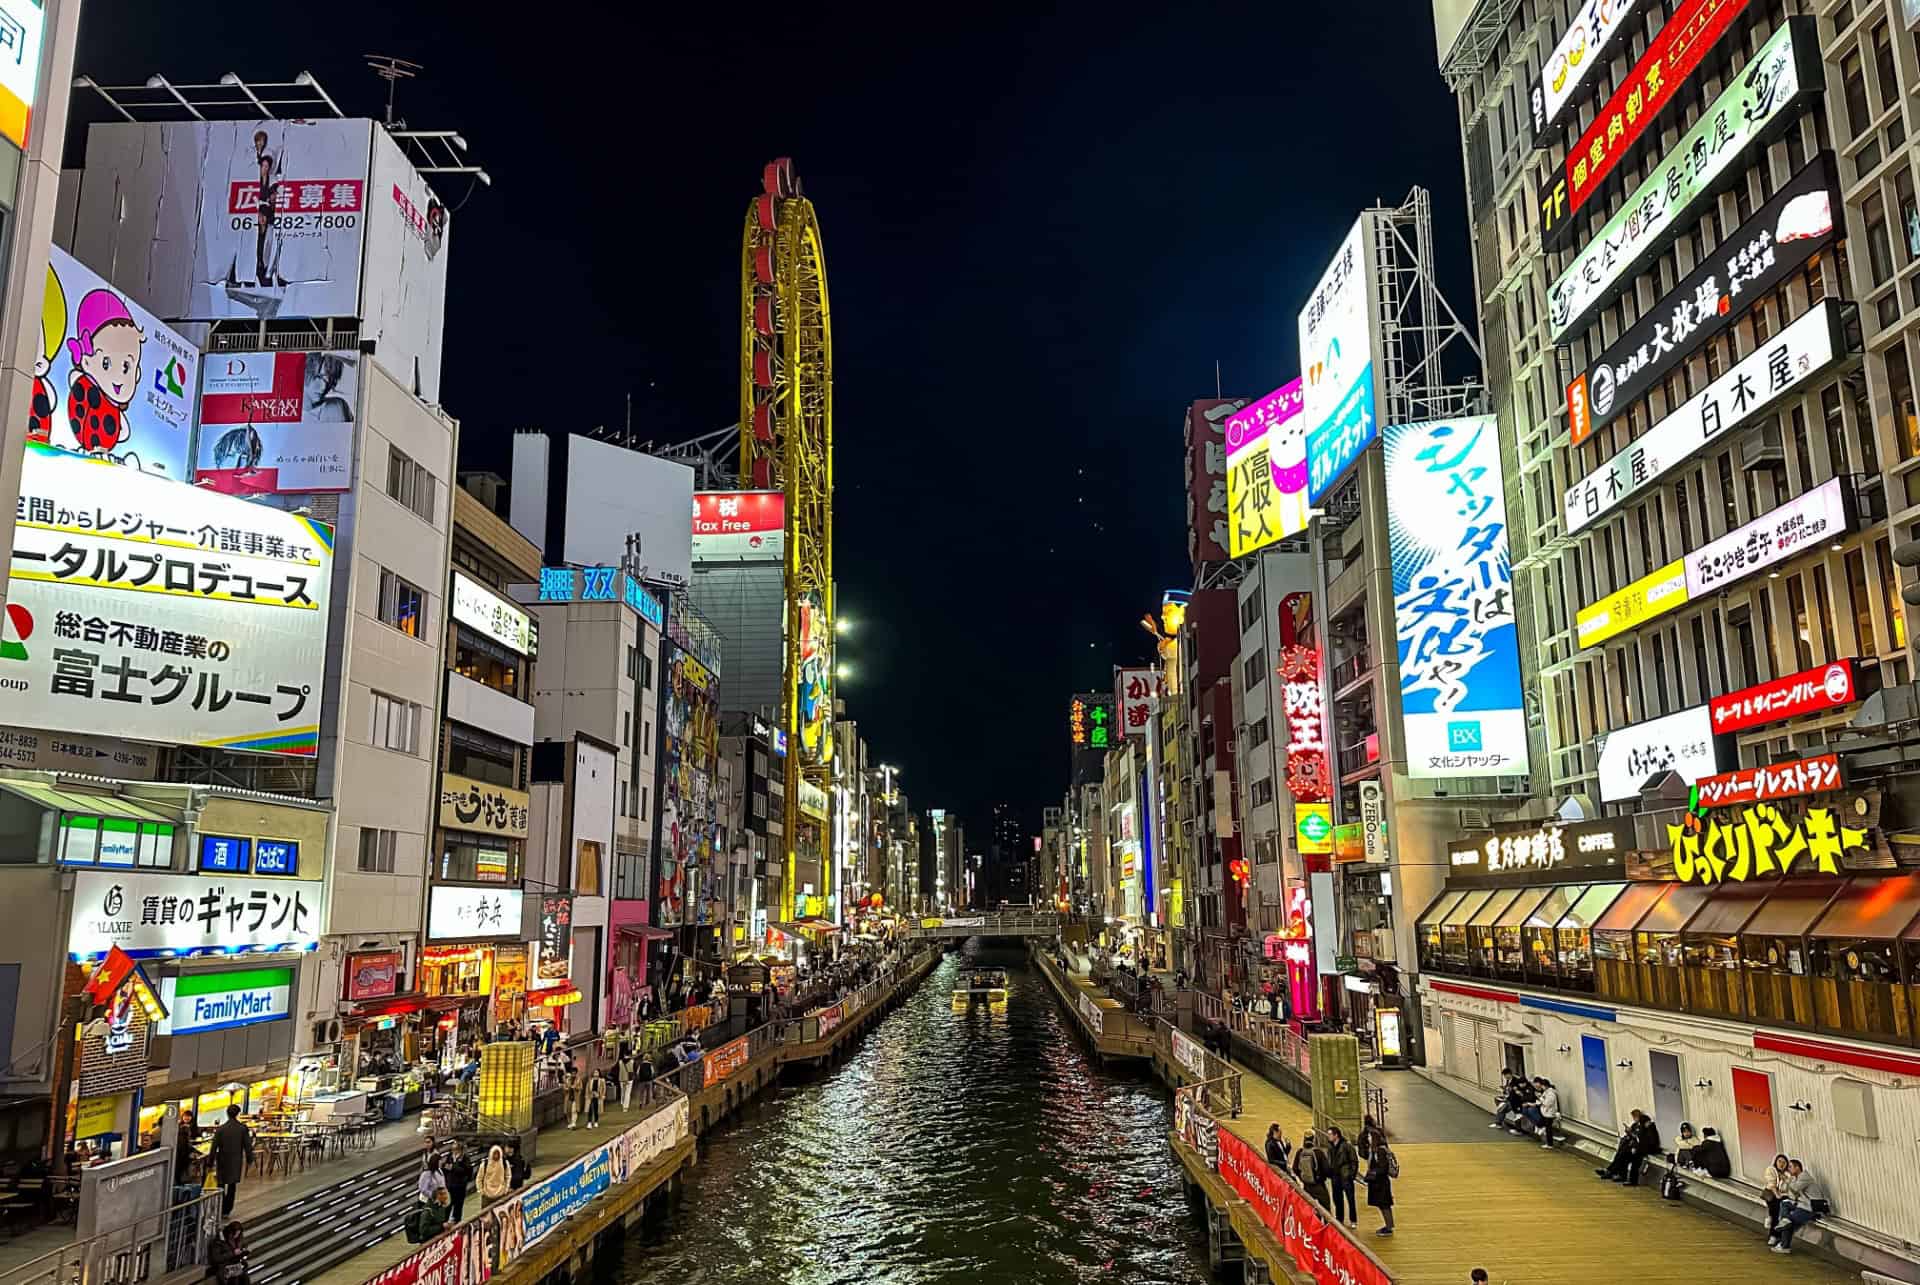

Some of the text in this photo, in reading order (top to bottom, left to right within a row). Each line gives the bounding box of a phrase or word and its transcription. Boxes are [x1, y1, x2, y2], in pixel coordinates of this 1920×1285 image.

[231, 215, 355, 231] 06-282-7800
[1542, 180, 1565, 231] 7F
[1571, 382, 1586, 438] 5F
[1702, 344, 1794, 438] 白木屋
[1232, 457, 1251, 551] バイト
[1585, 448, 1649, 517] 白木屋
[695, 520, 750, 532] Tax Free
[54, 610, 230, 663] 総合不動産業の
[51, 648, 311, 722] 富士グループ
[1452, 728, 1478, 745] BX
[1428, 754, 1511, 769] 文化シャッター
[1699, 761, 1838, 801] ハンバーグレストラン
[100, 843, 133, 855] FamilyMart
[215, 842, 287, 868] 酒 たばこ
[1667, 804, 1869, 884] びっくりドンキー
[89, 921, 133, 933] ALAXIE
[141, 886, 309, 933] 賃貸のギャラント
[194, 992, 272, 1021] FamilyMart
